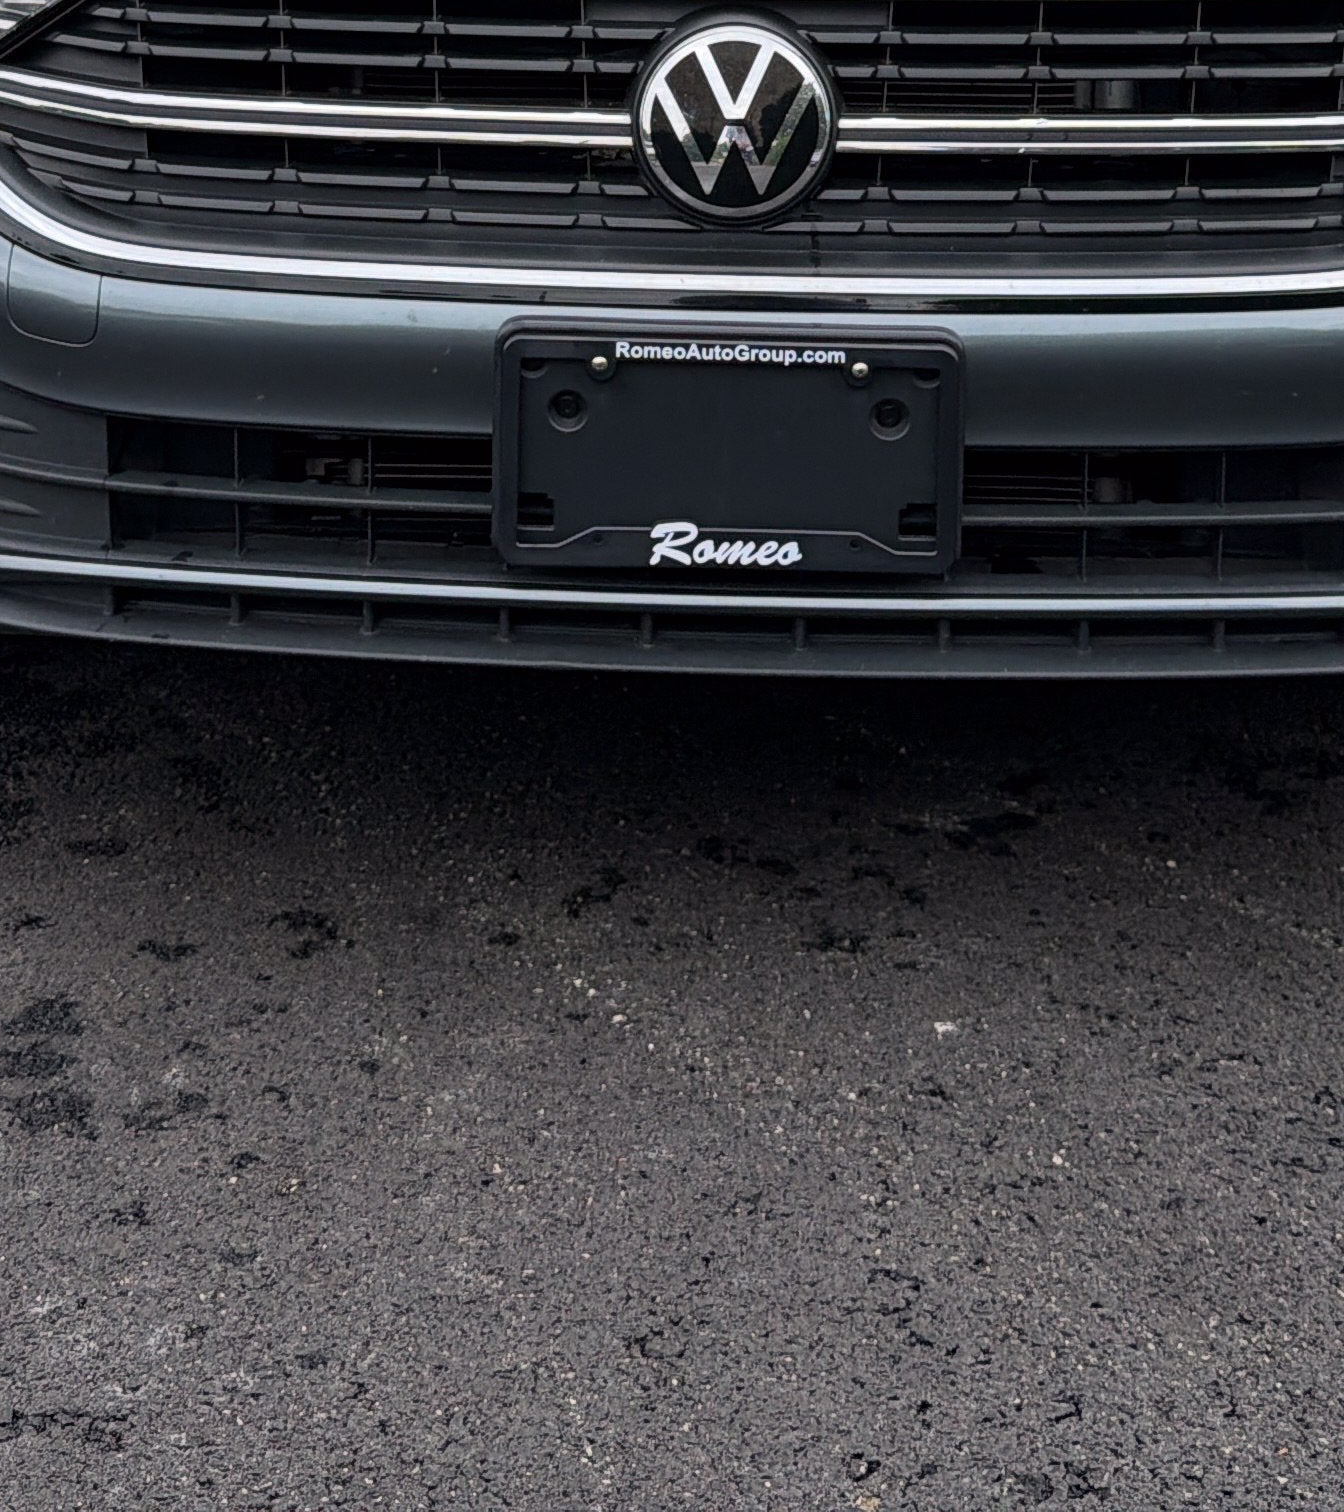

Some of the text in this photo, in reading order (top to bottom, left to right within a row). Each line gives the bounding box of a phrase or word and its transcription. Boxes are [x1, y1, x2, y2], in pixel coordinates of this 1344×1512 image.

[649, 36, 824, 200] VW
[615, 341, 846, 366] RomeoAutoGroup.com
[649, 521, 803, 566] Romeo
